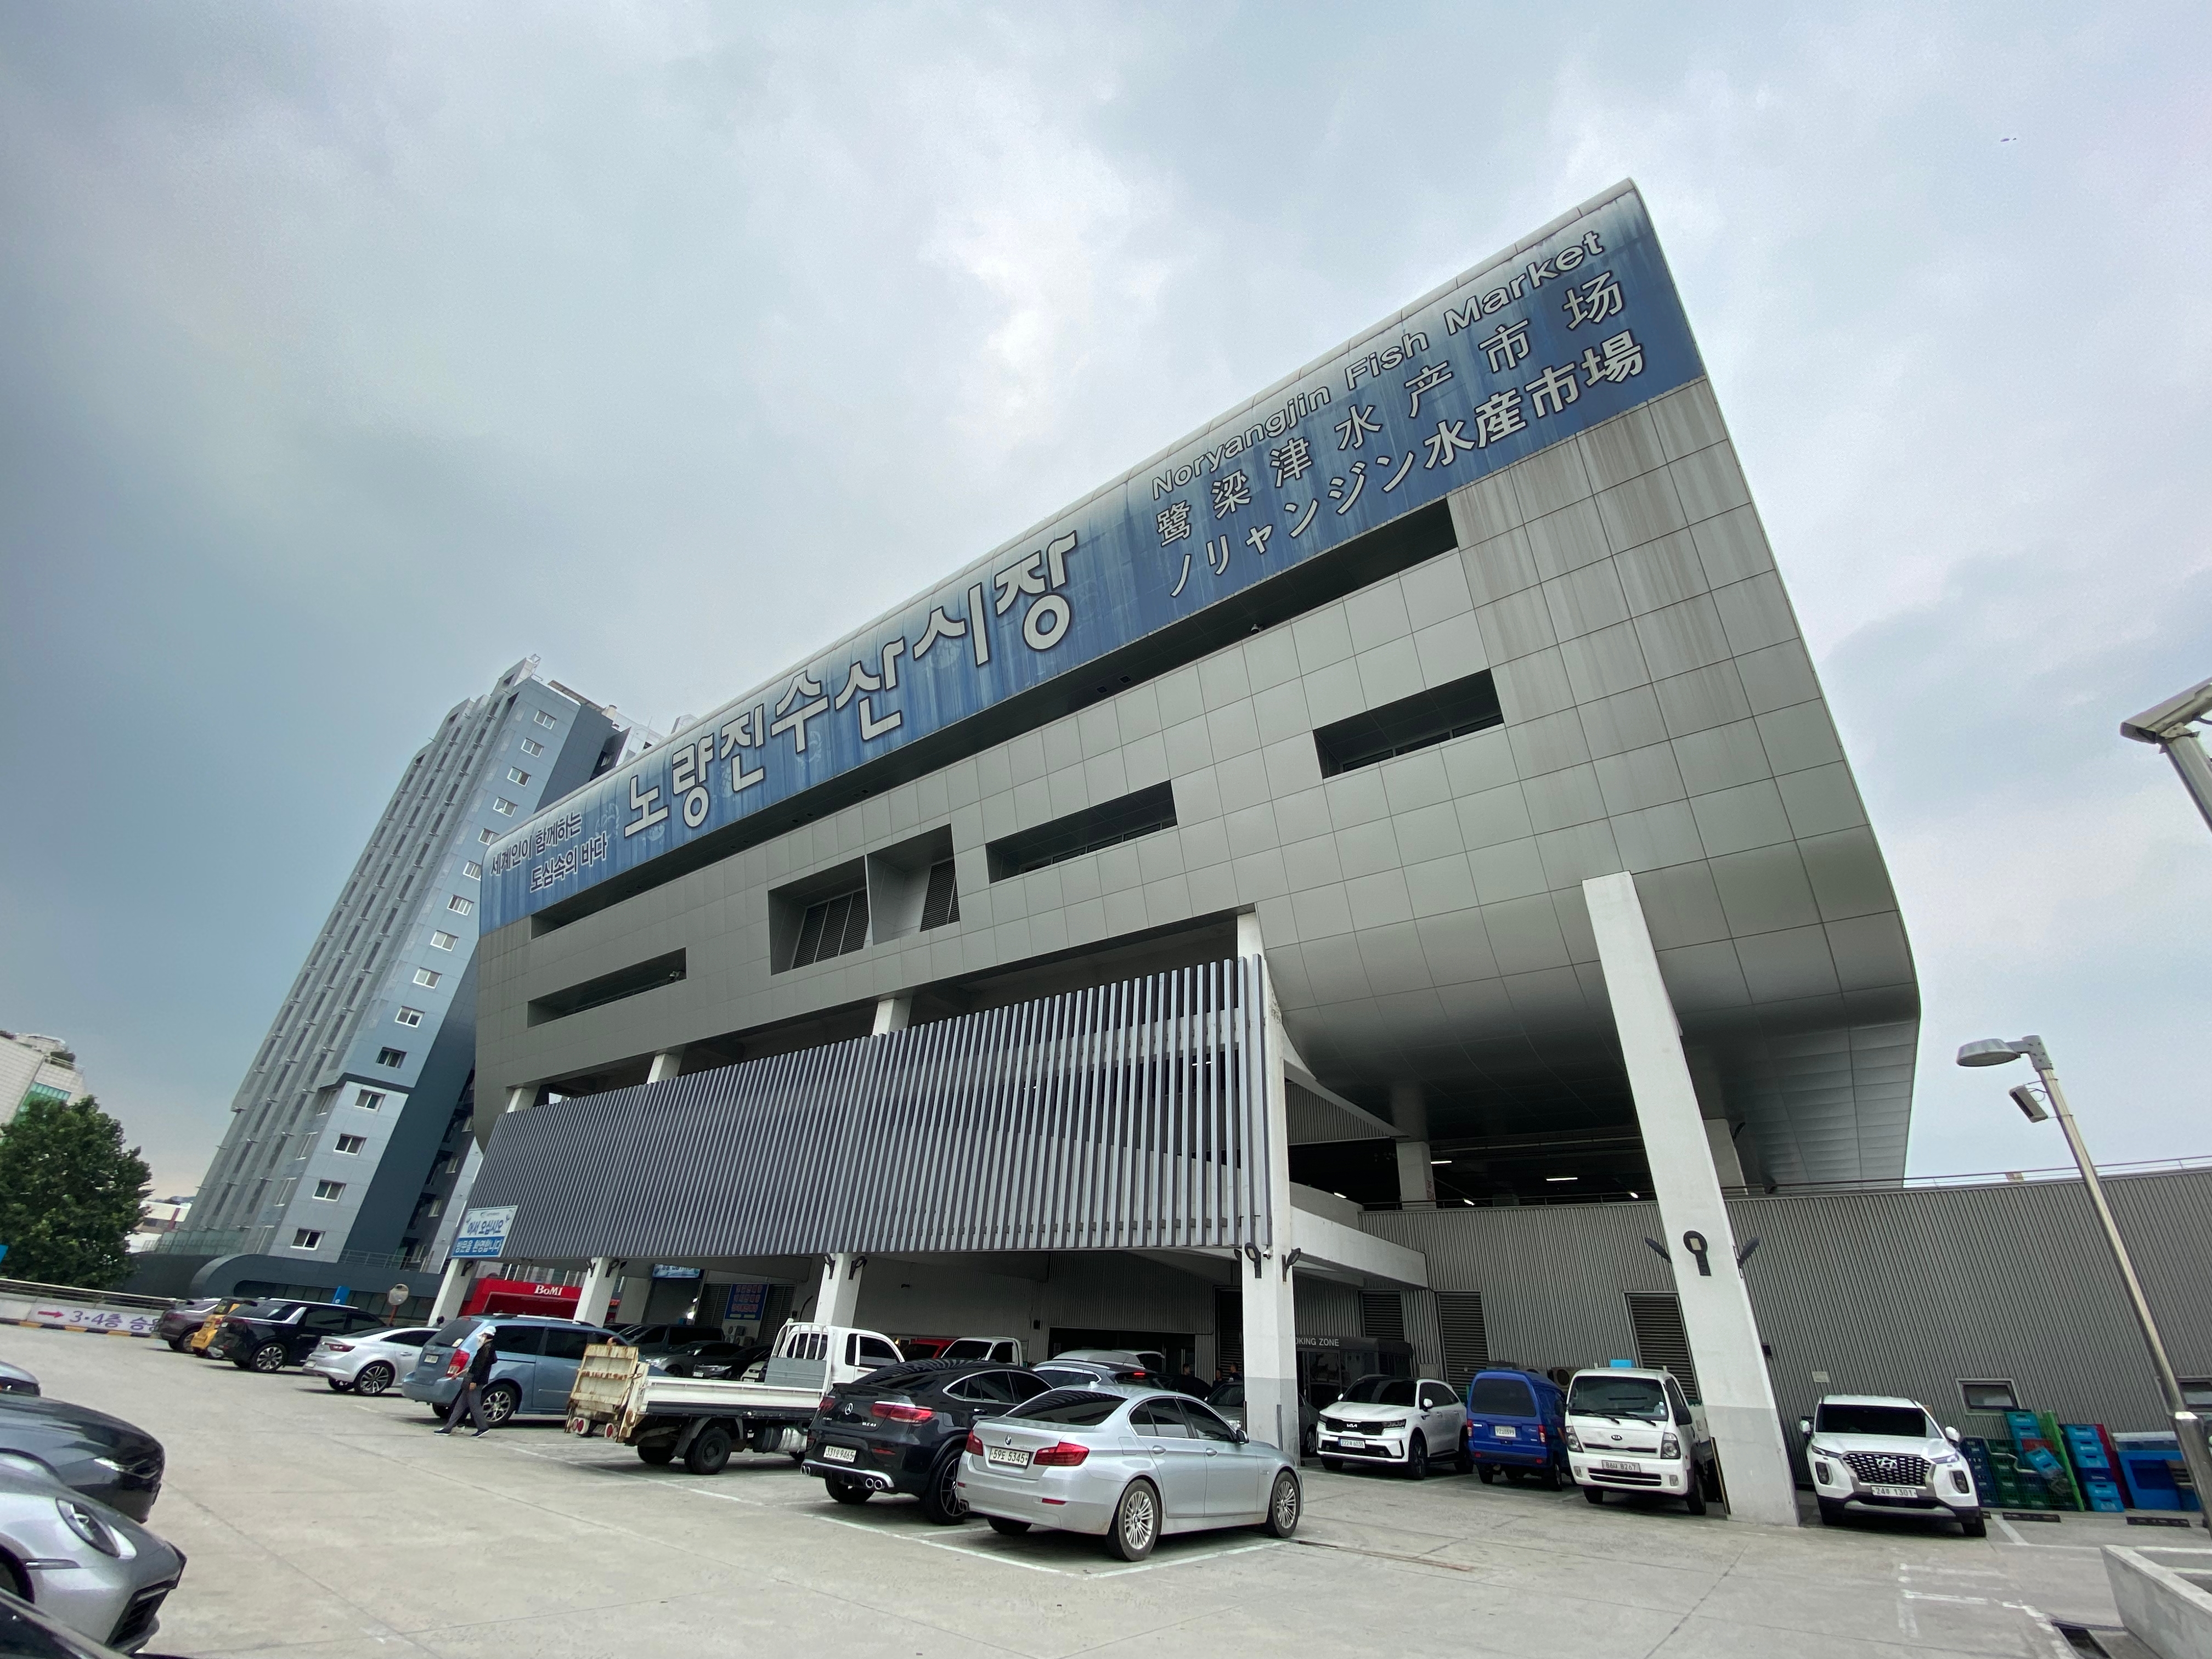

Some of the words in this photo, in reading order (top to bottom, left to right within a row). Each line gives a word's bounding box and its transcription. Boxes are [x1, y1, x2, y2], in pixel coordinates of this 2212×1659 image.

[1152, 384, 1331, 500] Noryangjin
[1344, 327, 1429, 391] Fish
[1442, 230, 1605, 334] Market
[1156, 271, 1623, 546] 鹭梁津水产市场
[1171, 330, 1644, 598] ノリャンジン水産市場
[624, 530, 1077, 838] 노량진수산시장
[490, 834, 532, 876] 세계인이
[535, 812, 582, 855] 함께하는
[531, 846, 578, 893] 도심속의
[581, 831, 607, 866] 바다
[467, 1221, 481, 1235] 어서
[478, 1220, 504, 1235] 오십시오
[1319, 1338, 1339, 1346] ZONE
[1008, 1451, 1025, 1463] 5345
[1894, 1488, 1913, 1497] 1301
